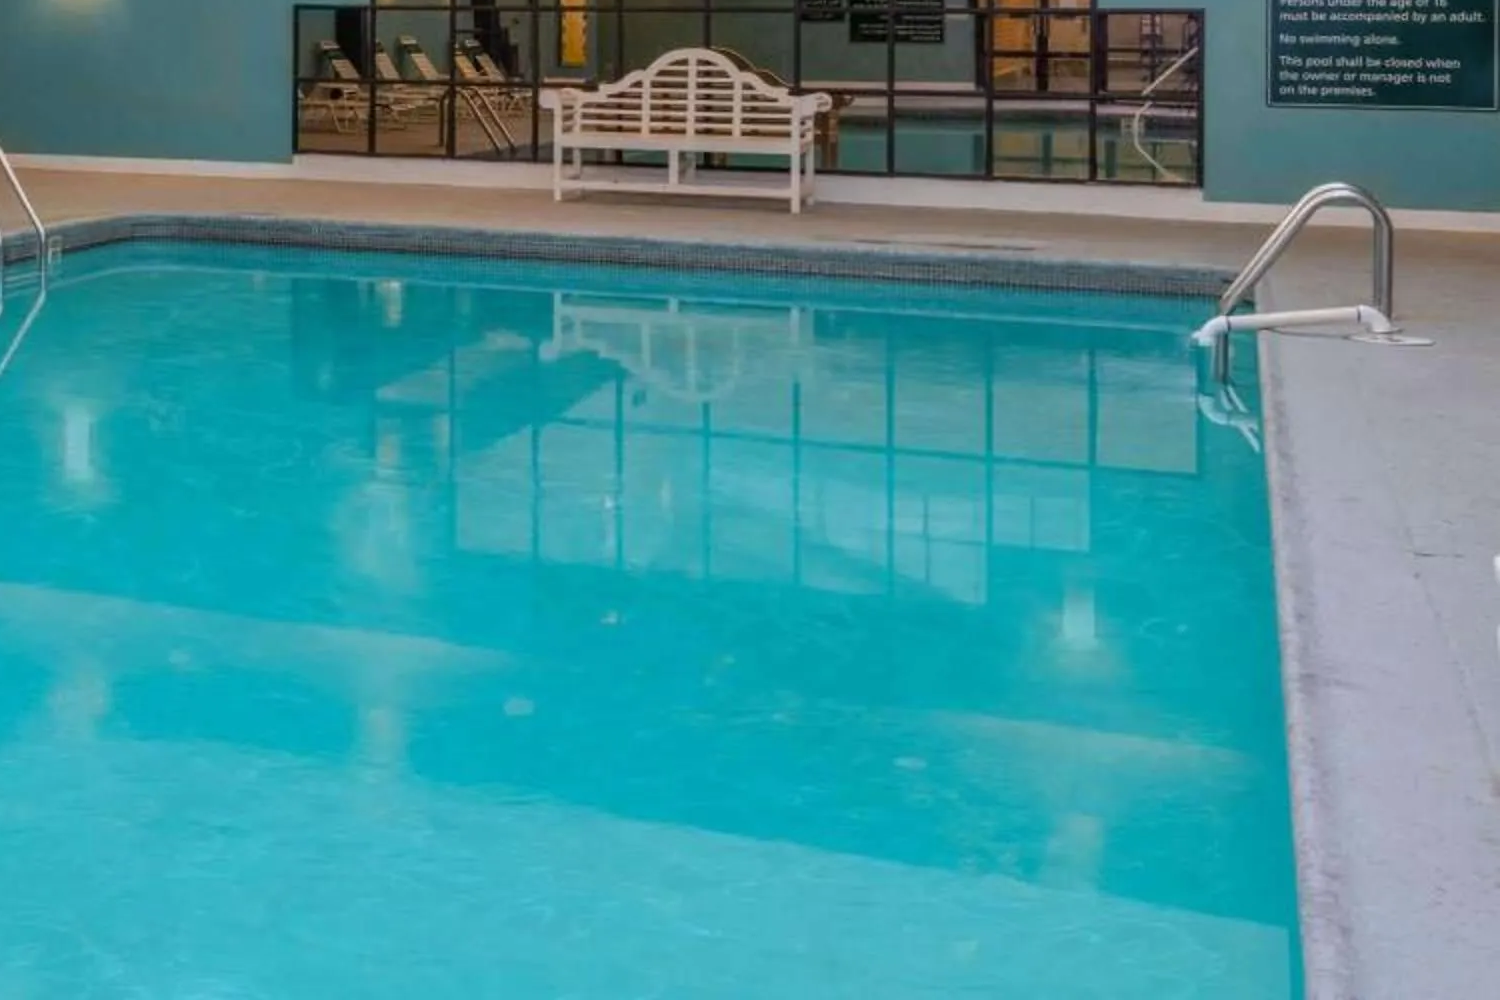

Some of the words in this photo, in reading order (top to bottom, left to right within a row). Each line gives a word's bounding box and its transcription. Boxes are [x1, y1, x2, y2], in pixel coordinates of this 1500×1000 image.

[1280, 12, 1308, 21] must
[1312, 11, 1327, 21] be
[1330, 11, 1409, 23] accompanied
[1412, 12, 1426, 24] by
[1431, 13, 1446, 22] an
[1449, 12, 1485, 22] adult.
[1279, 34, 1296, 43] No
[1300, 34, 1361, 47] swimming
[1279, 56, 1302, 66] This
[1306, 56, 1333, 68] pool
[1335, 56, 1363, 66] shall
[1366, 57, 1381, 67] be
[1384, 57, 1423, 68] closed
[1426, 58, 1461, 68] when
[1279, 71, 1298, 81] the
[1302, 72, 1340, 81] owner
[1344, 72, 1356, 81] or
[1359, 72, 1413, 84] manager
[1417, 73, 1426, 83] is
[1429, 73, 1451, 83] not
[1279, 87, 1294, 95] on
[1298, 85, 1318, 95] the
[1321, 86, 1376, 97] premises.
